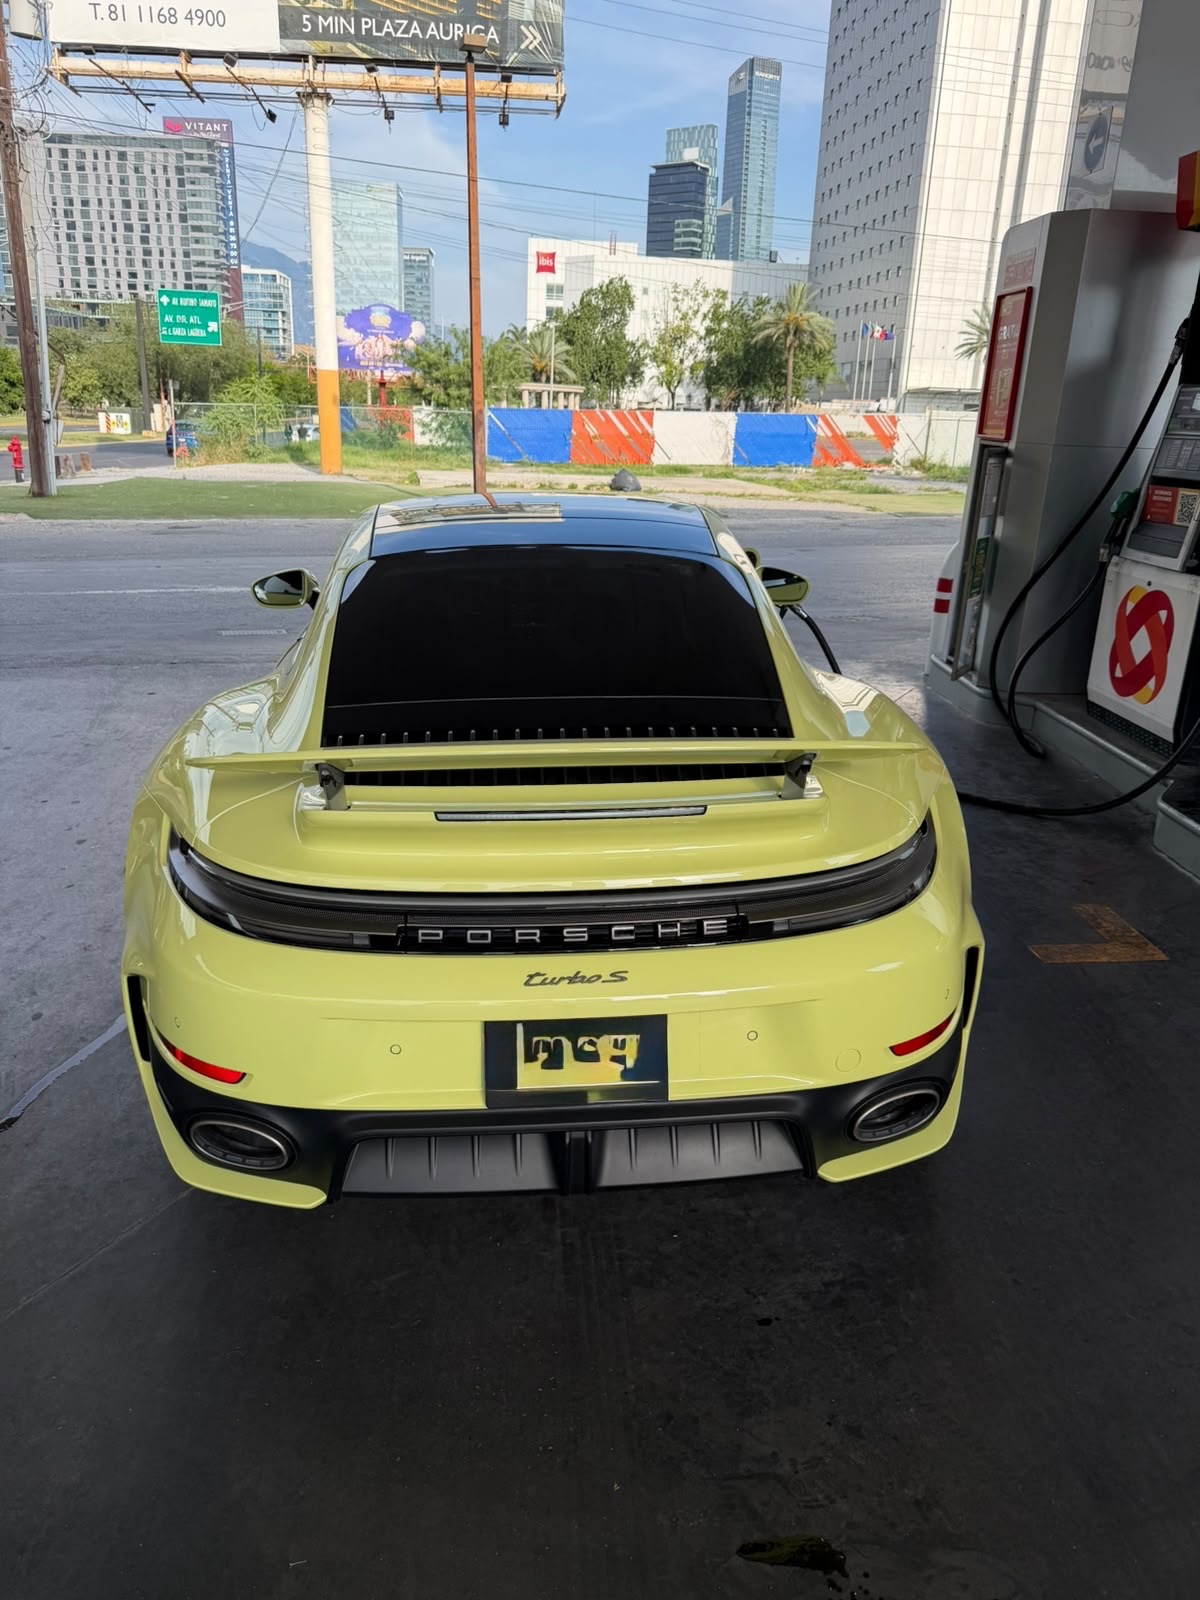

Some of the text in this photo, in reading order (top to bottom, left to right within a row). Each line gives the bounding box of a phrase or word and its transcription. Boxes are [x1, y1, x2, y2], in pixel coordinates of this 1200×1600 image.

[138, 5, 178, 25] 1168
[184, 8, 226, 28] 4900
[302, 15, 312, 33] 5
[318, 15, 355, 35] MIN
[361, 18, 423, 39] PLAZA
[184, 121, 228, 132] VITANT
[539, 256, 553, 267] ibis
[418, 919, 728, 944] PORSCHE
[523, 970, 629, 987] turbo S
